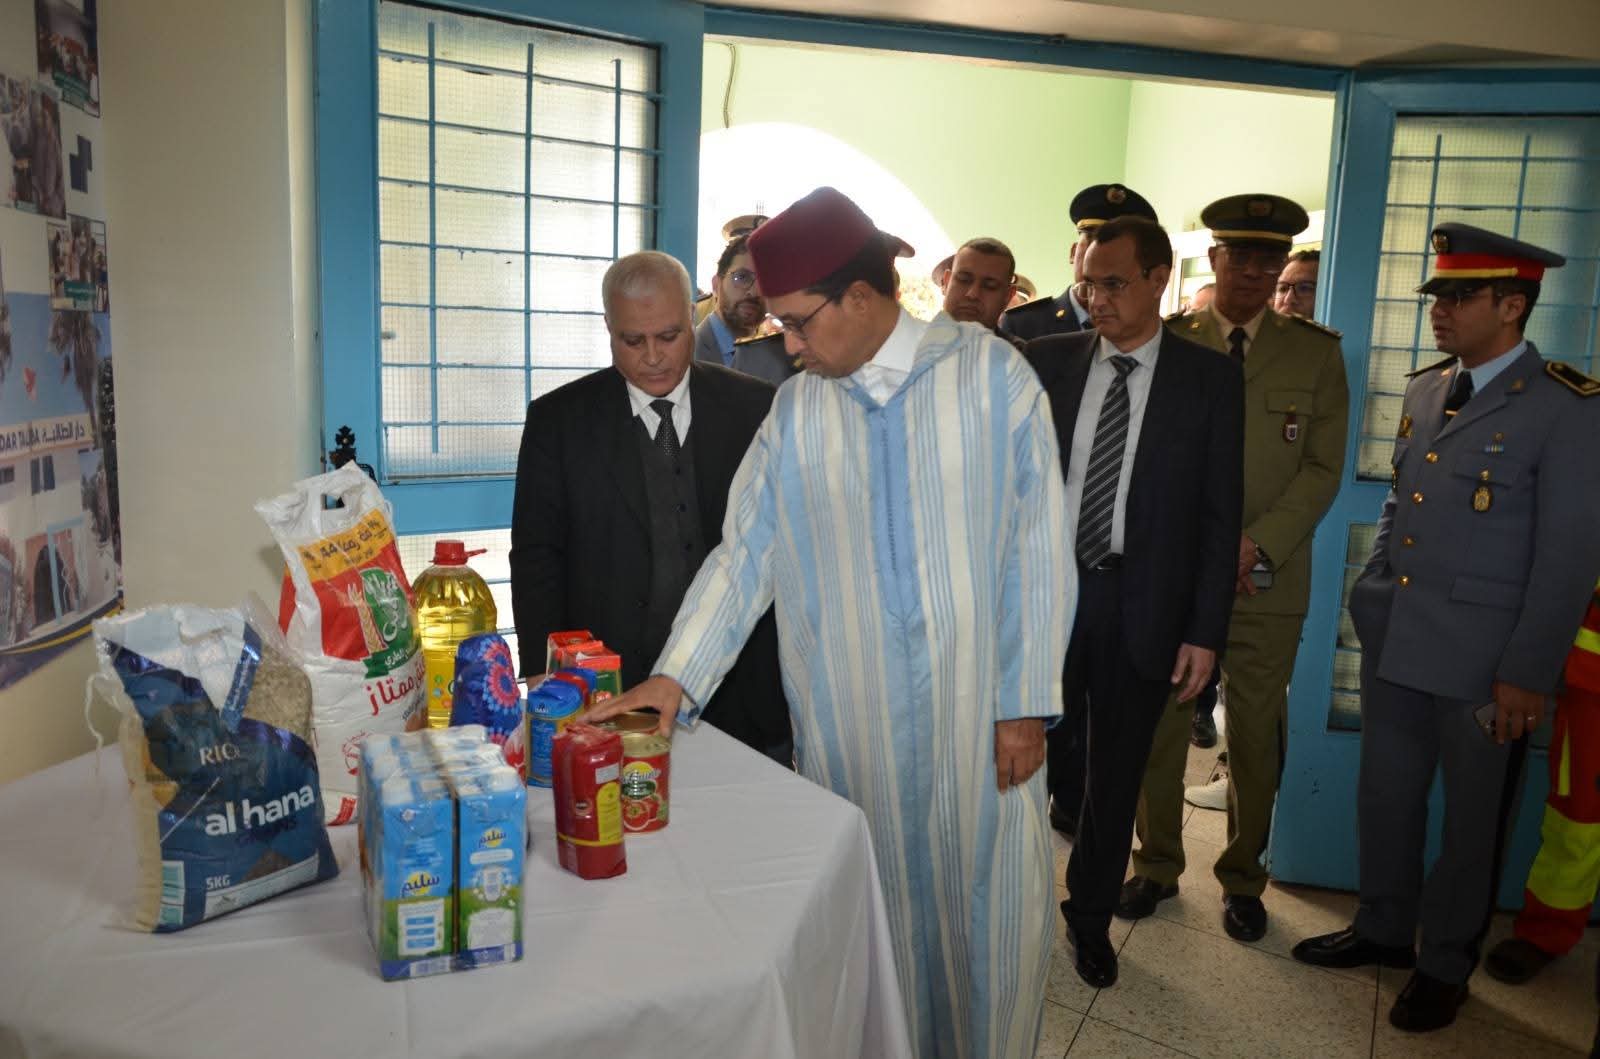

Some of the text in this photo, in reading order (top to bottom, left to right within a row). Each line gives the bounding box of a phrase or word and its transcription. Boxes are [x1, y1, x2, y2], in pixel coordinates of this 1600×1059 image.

[204, 801, 236, 836] al
[242, 785, 315, 827] hana
[205, 874, 231, 890] 5KG
[401, 873, 440, 899] سليم
